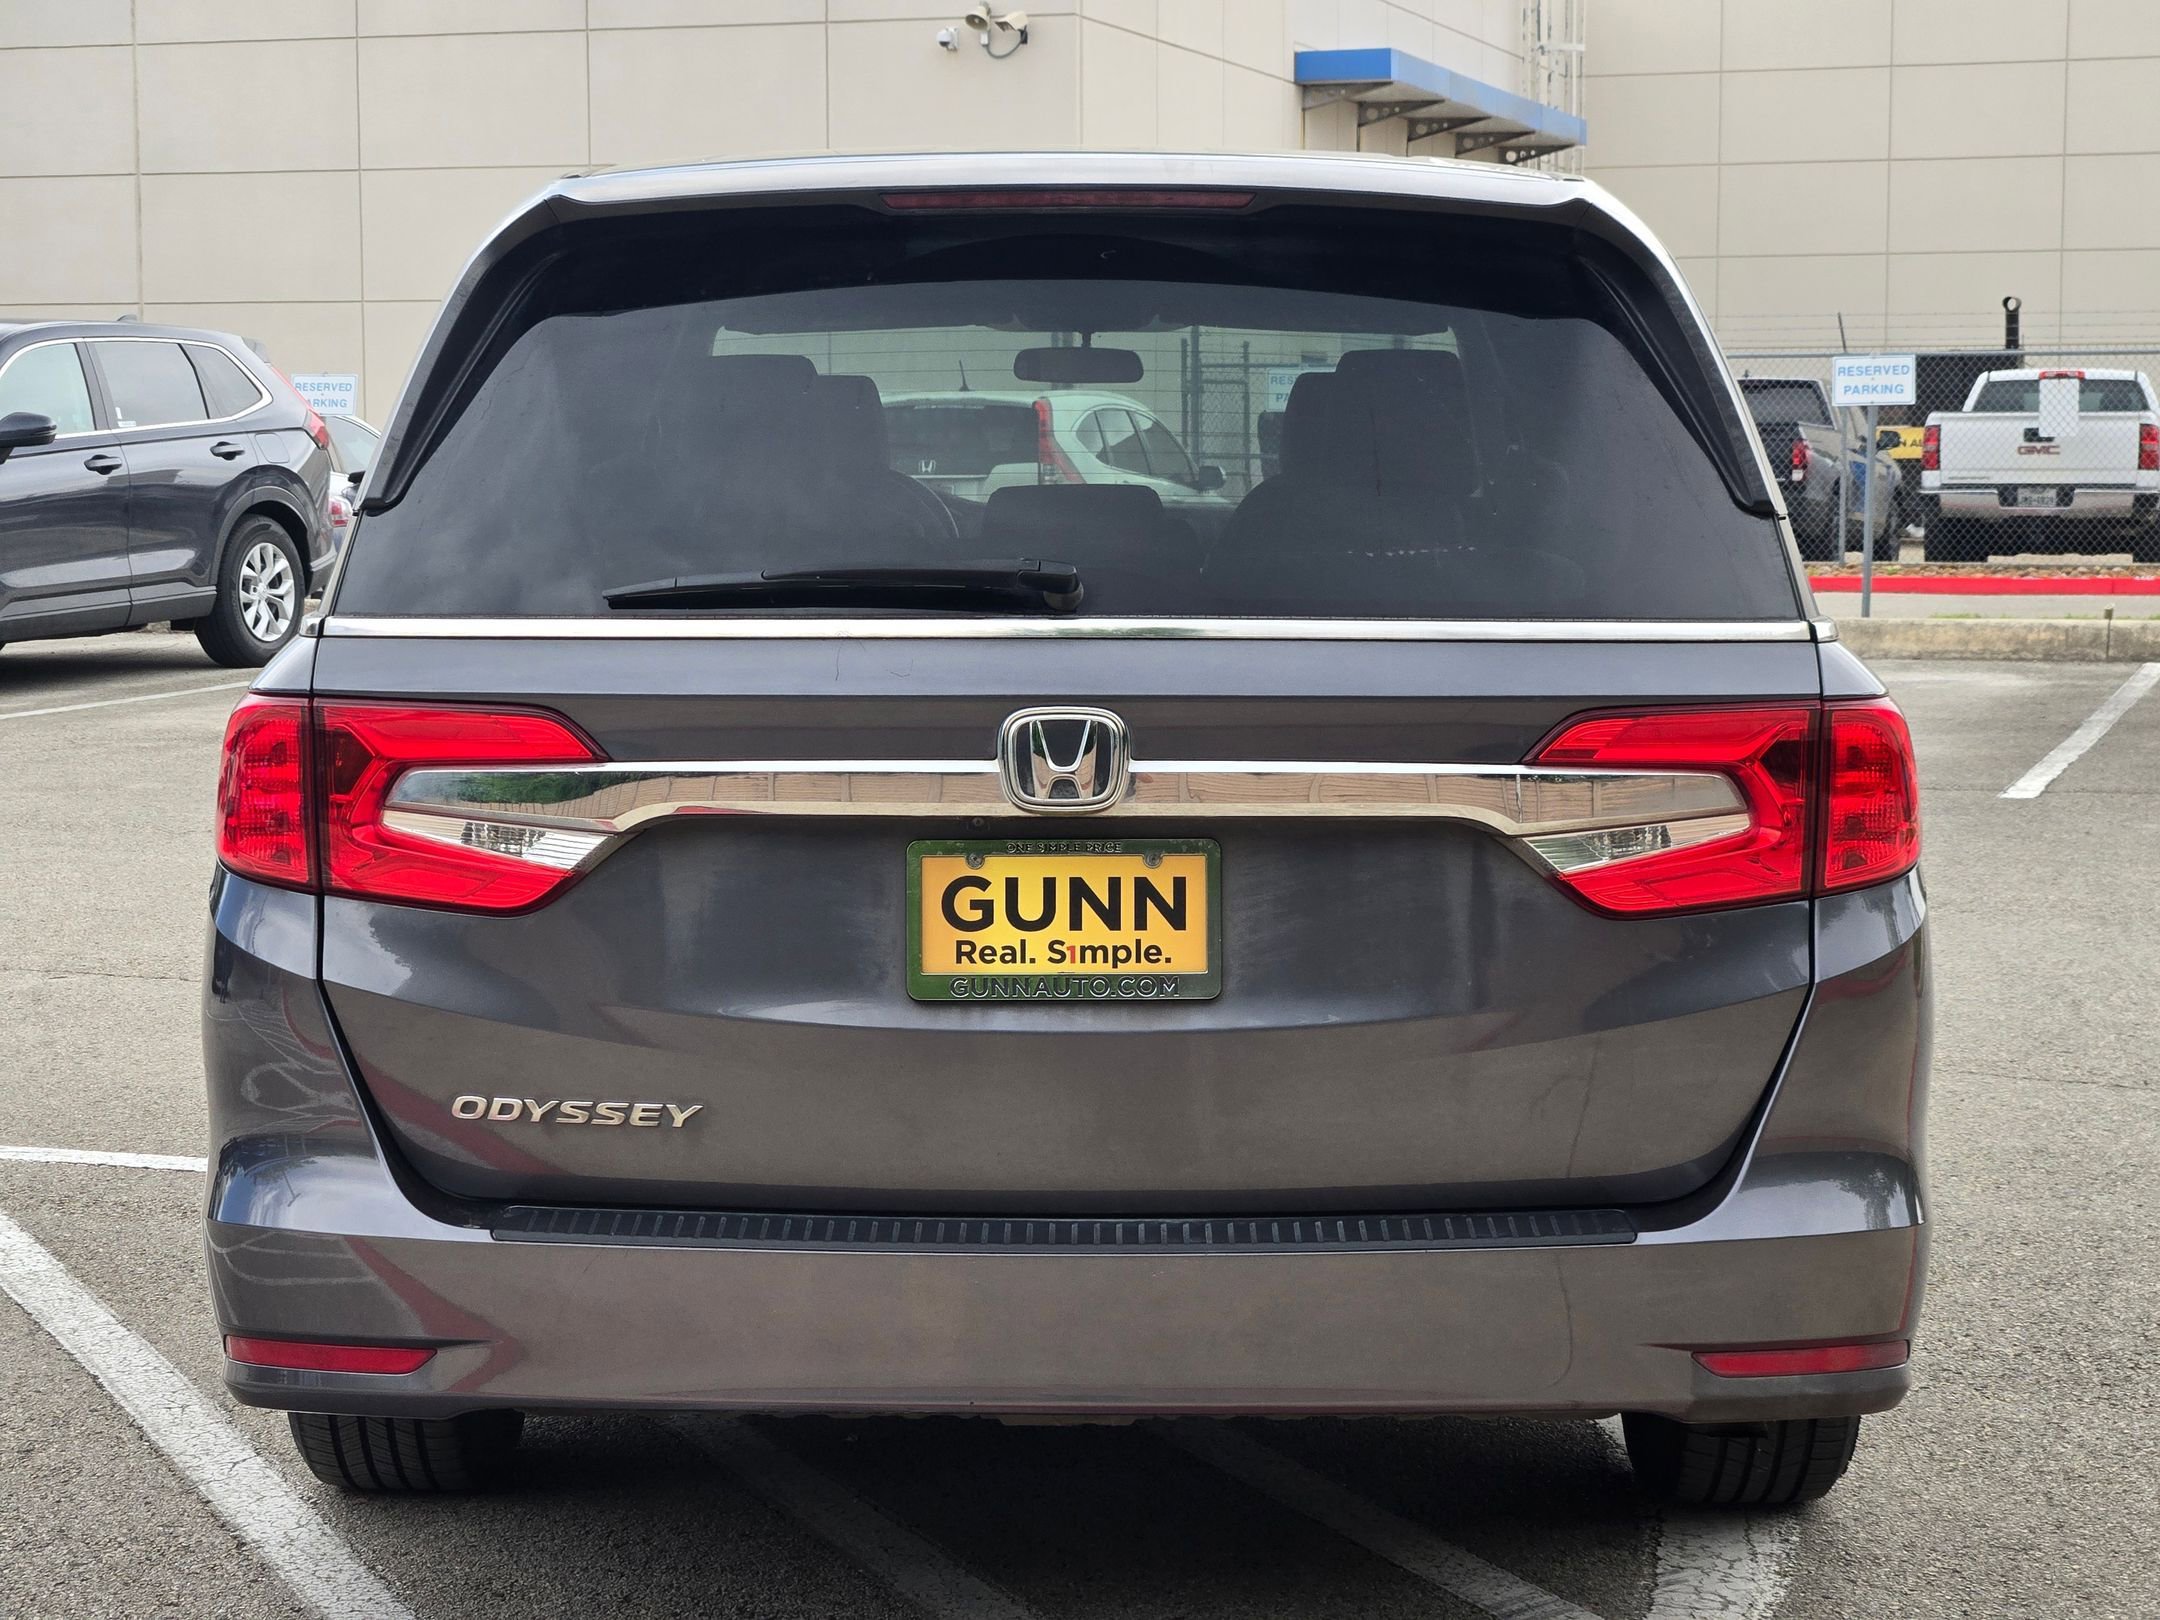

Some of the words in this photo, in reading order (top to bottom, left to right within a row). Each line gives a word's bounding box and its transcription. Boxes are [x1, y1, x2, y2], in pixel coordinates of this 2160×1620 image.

[1837, 365, 1910, 376] RESERVED
[294, 382, 352, 392] RESERVED
[1843, 384, 1904, 395] PARKING
[2017, 445, 2061, 455] GMC
[1006, 842, 1032, 853] ONE
[1037, 842, 1081, 853] SIMPLE
[1085, 841, 1121, 853] PRICE
[941, 875, 1187, 932] GUNN
[955, 939, 1036, 964] Real.
[949, 975, 1180, 998] GUNNAUTO.COM
[451, 1095, 704, 1128] ODYSSEY
